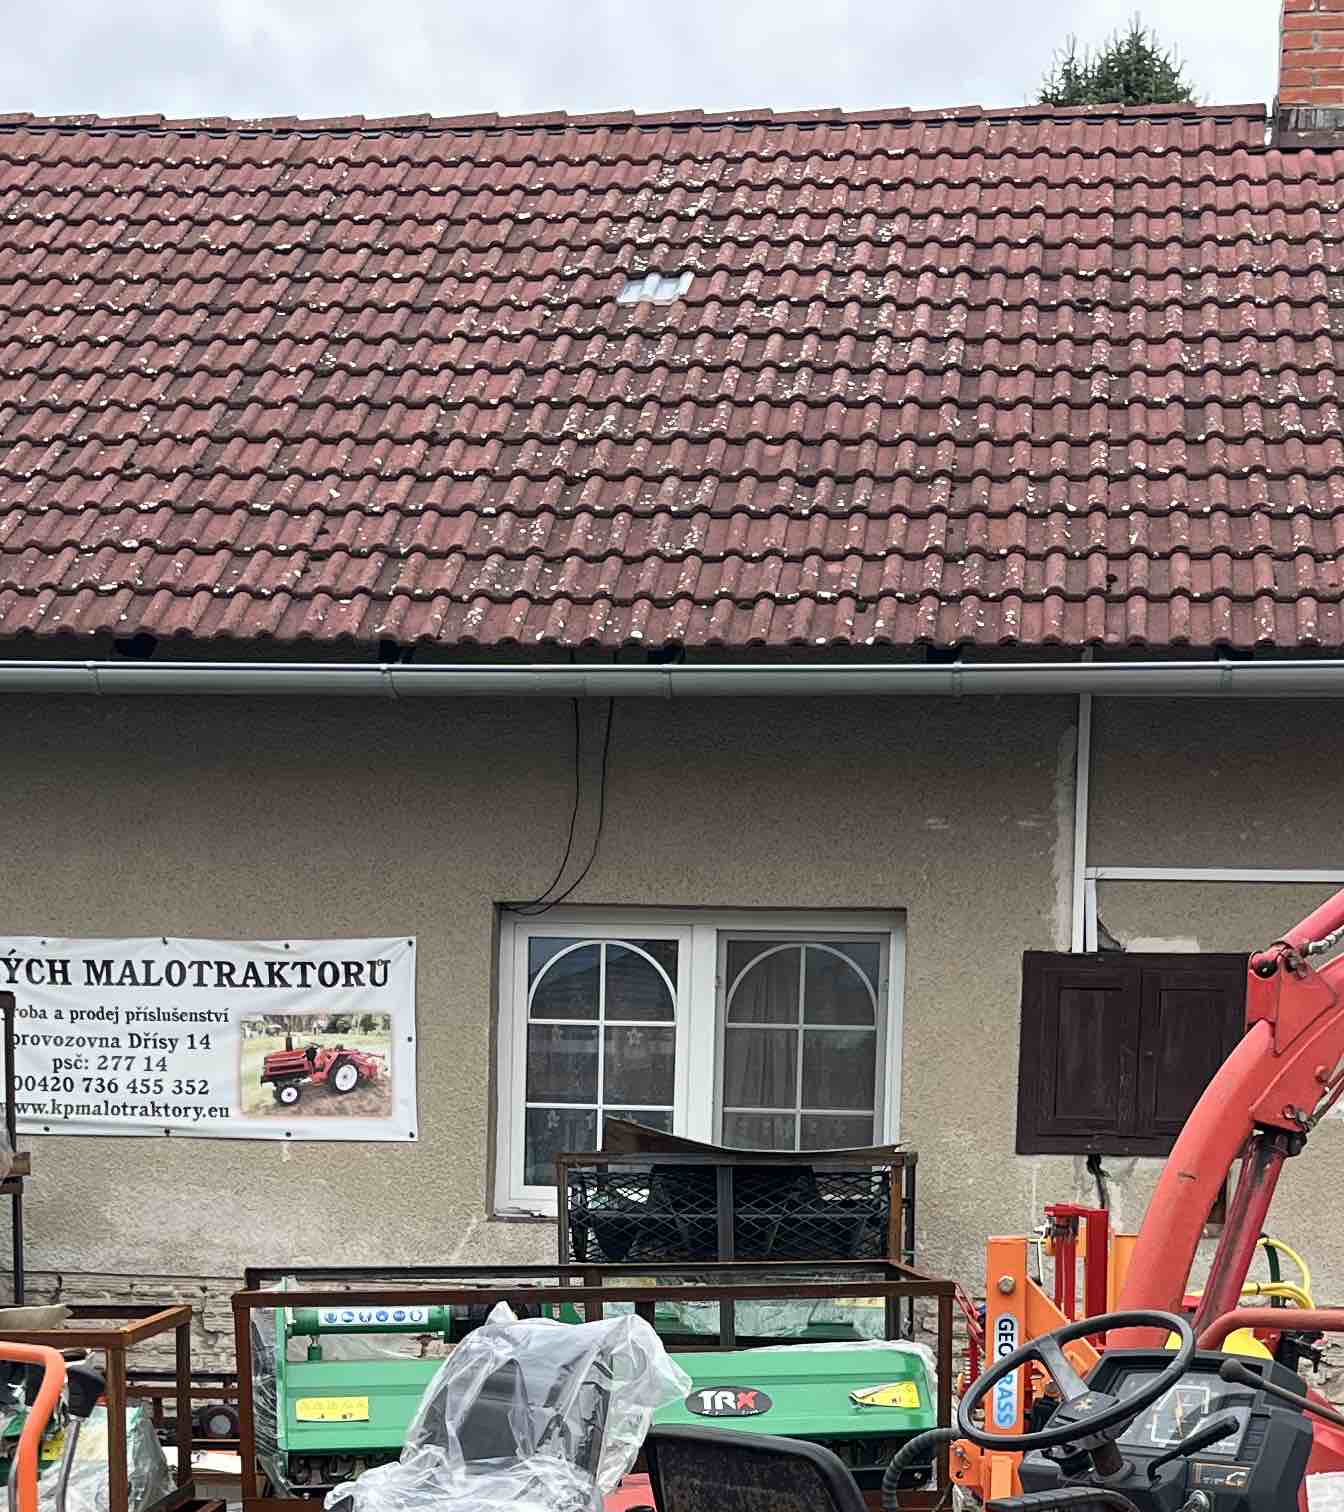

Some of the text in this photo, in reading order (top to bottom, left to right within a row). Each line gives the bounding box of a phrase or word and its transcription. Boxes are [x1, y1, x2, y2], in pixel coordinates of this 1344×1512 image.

[83, 959, 392, 989] MALOTRAKTORŮ
[54, 1008, 65, 1020] a
[70, 1006, 120, 1024] prodej
[126, 1007, 230, 1024] příslušenství
[128, 1032, 179, 1054] Dřísy
[187, 1033, 212, 1050] 14
[53, 1053, 168, 1073] psč: 277 14
[82, 1077, 119, 1093] 736
[126, 1078, 164, 1095] 455
[171, 1079, 209, 1095] 352
[0, 1098, 230, 1121] ww.kpmalotraktory.eu
[698, 1391, 758, 1410] TRX
